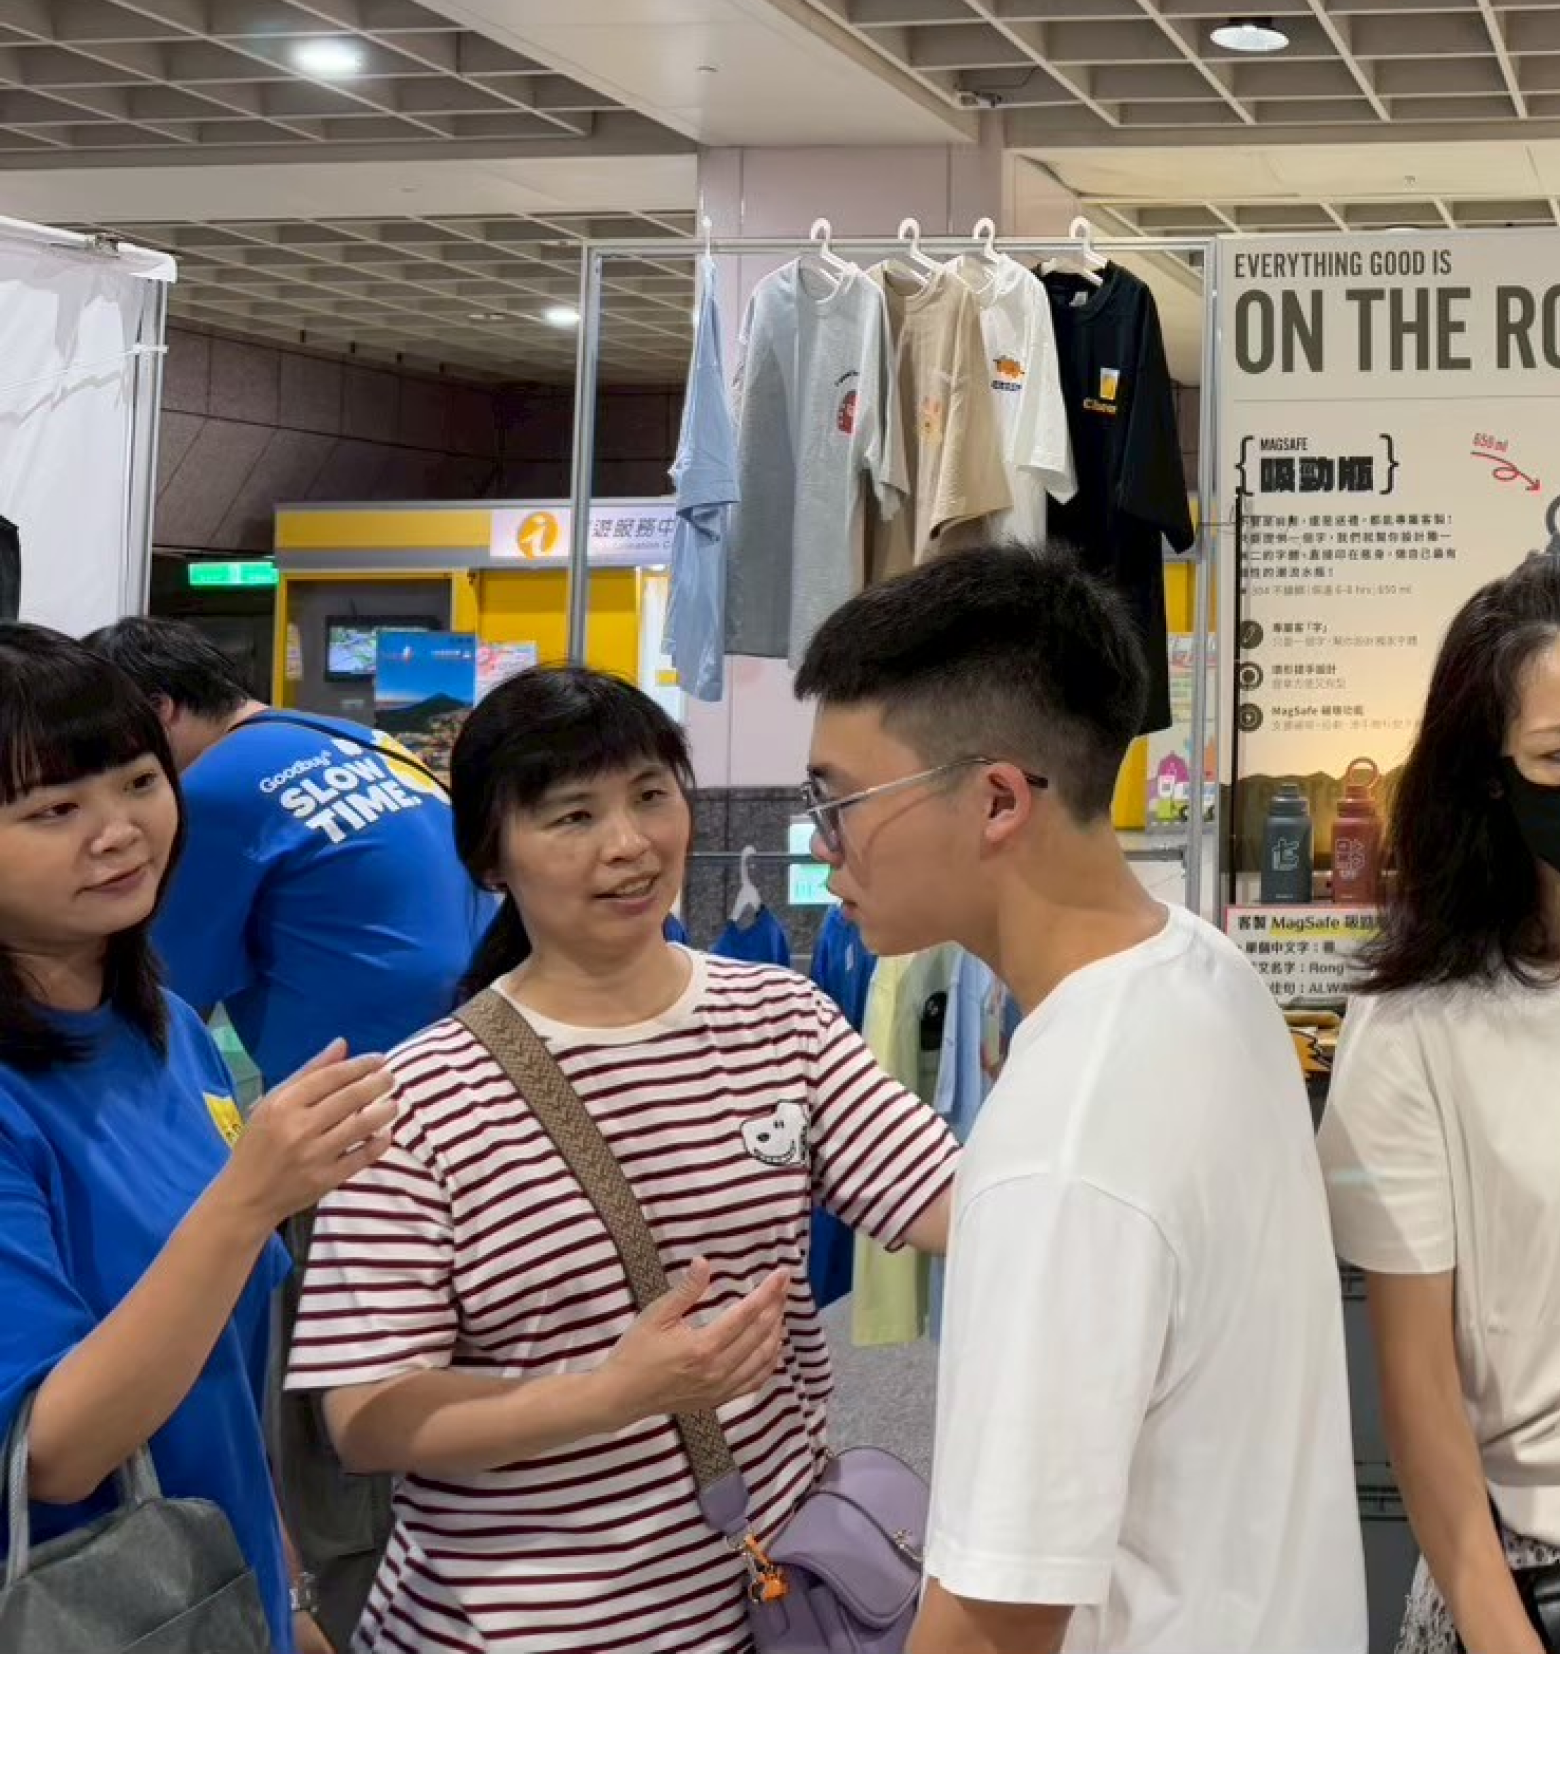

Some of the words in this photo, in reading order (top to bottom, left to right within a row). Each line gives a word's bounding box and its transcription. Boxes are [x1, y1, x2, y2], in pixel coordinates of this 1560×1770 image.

[1234, 252, 1362, 278] EVERYTHING
[1370, 250, 1425, 276] GOOD
[1432, 249, 1452, 275] IS
[1235, 289, 1323, 374] ON
[1346, 287, 1471, 371] THE
[1260, 437, 1308, 450] MAGSAFE
[280, 757, 387, 818] SLOW
[304, 779, 422, 844] TIME.
[1271, 914, 1340, 934] MagSafe
